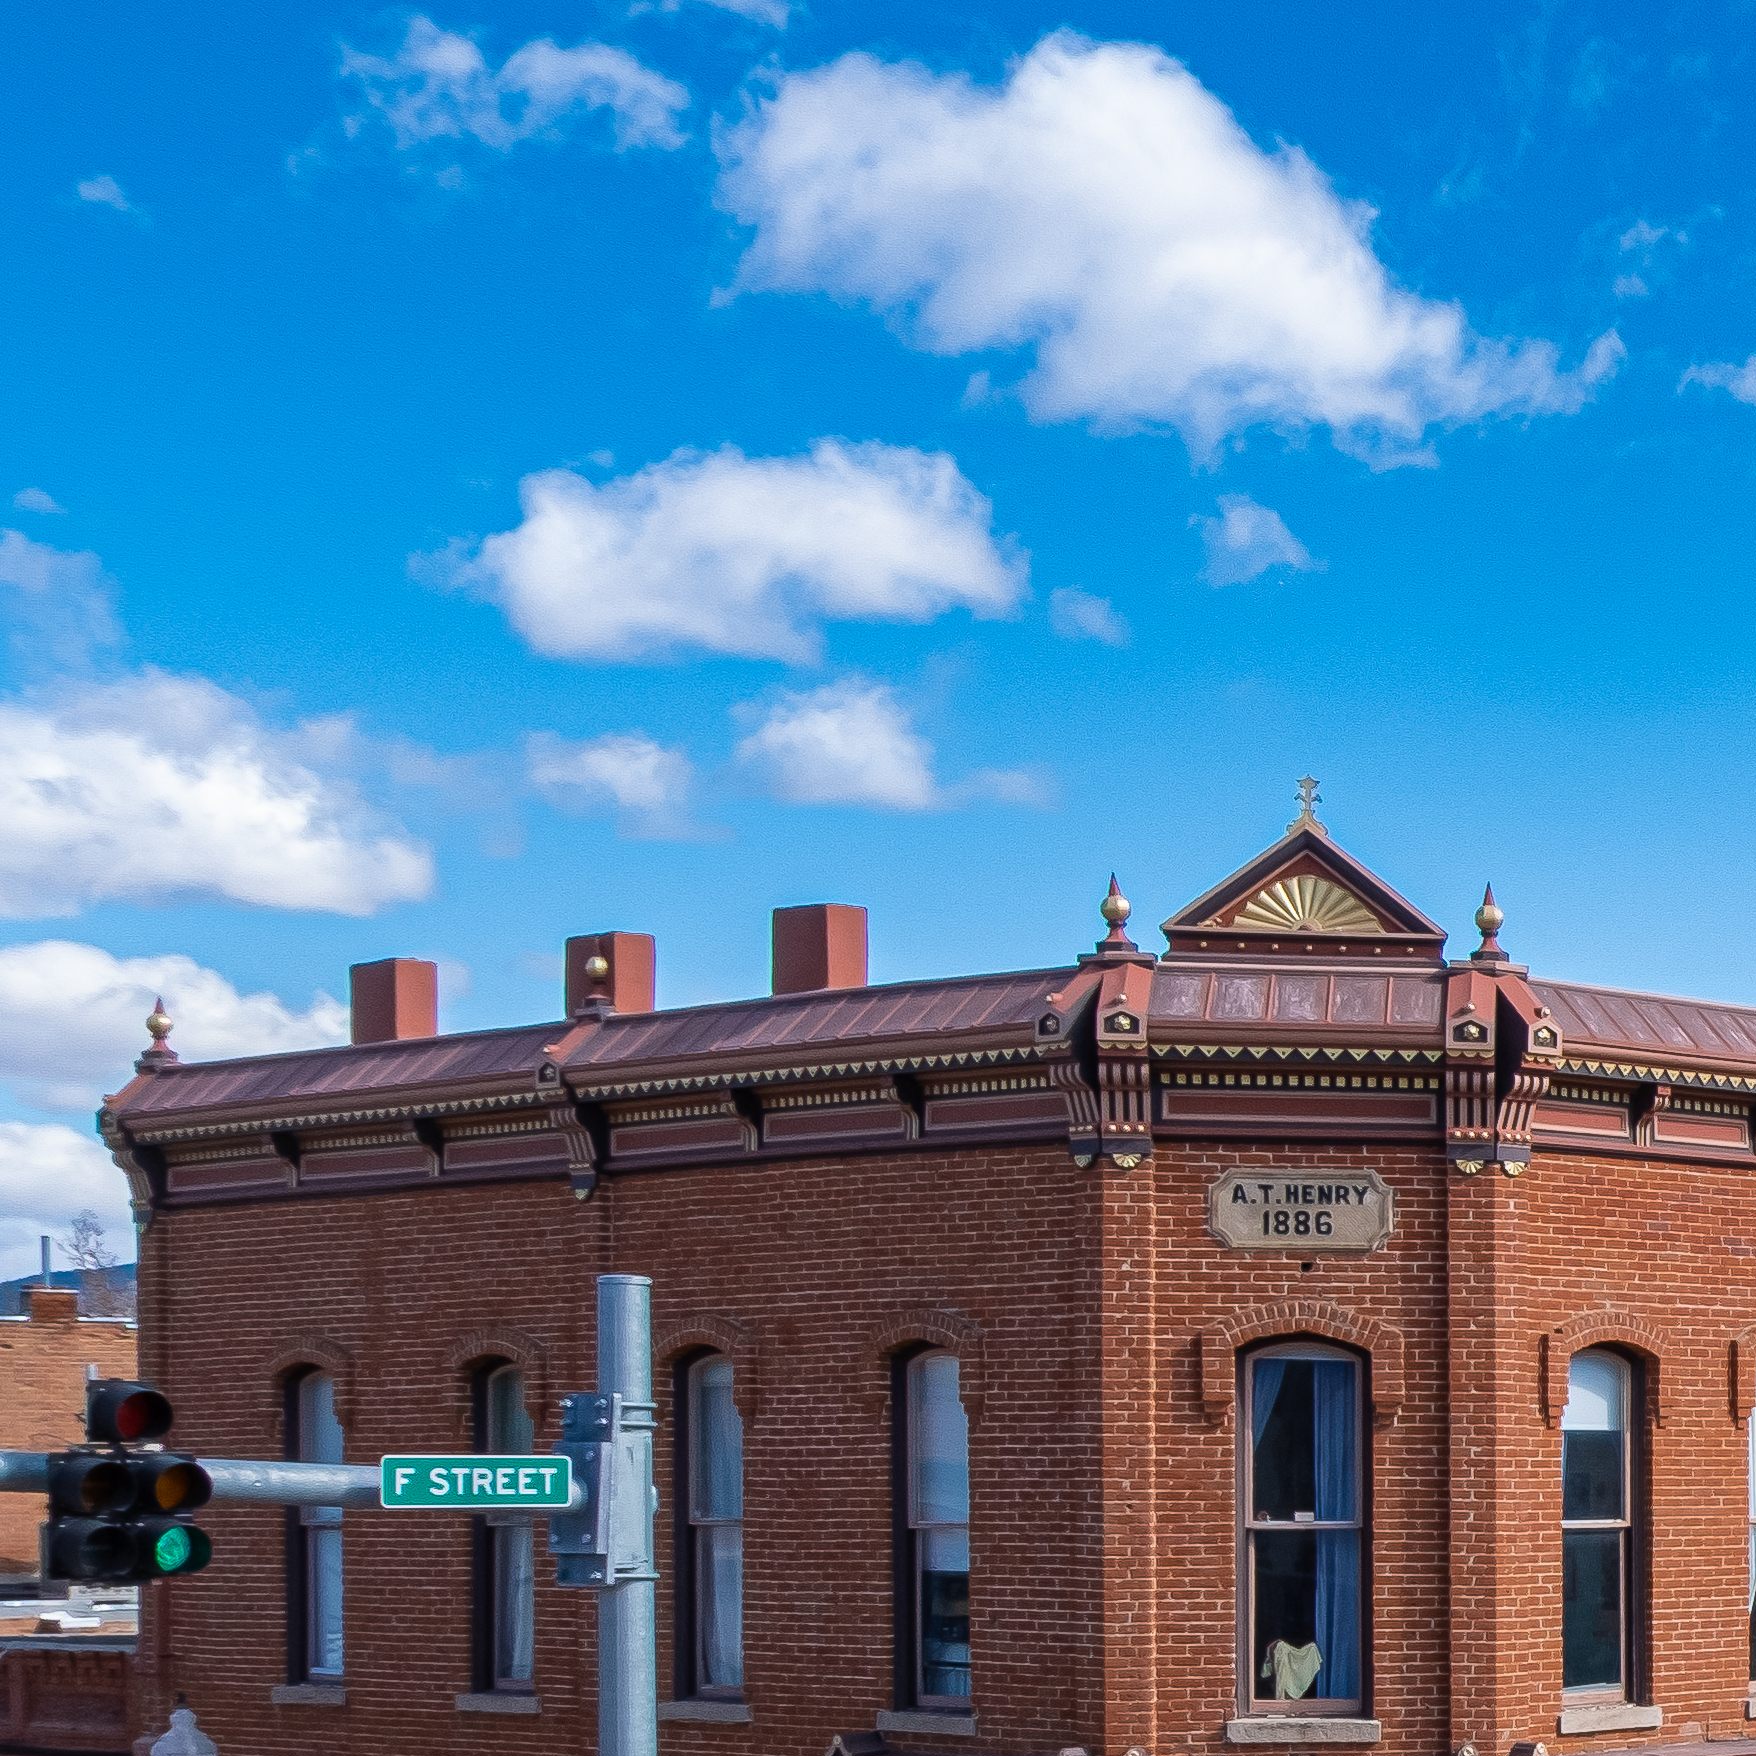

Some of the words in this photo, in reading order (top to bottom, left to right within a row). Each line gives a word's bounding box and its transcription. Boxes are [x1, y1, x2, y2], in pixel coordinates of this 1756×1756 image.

[1262, 1210, 1333, 1236] 1886
[394, 1471, 413, 1495] F
[429, 1467, 558, 1496] STREET
